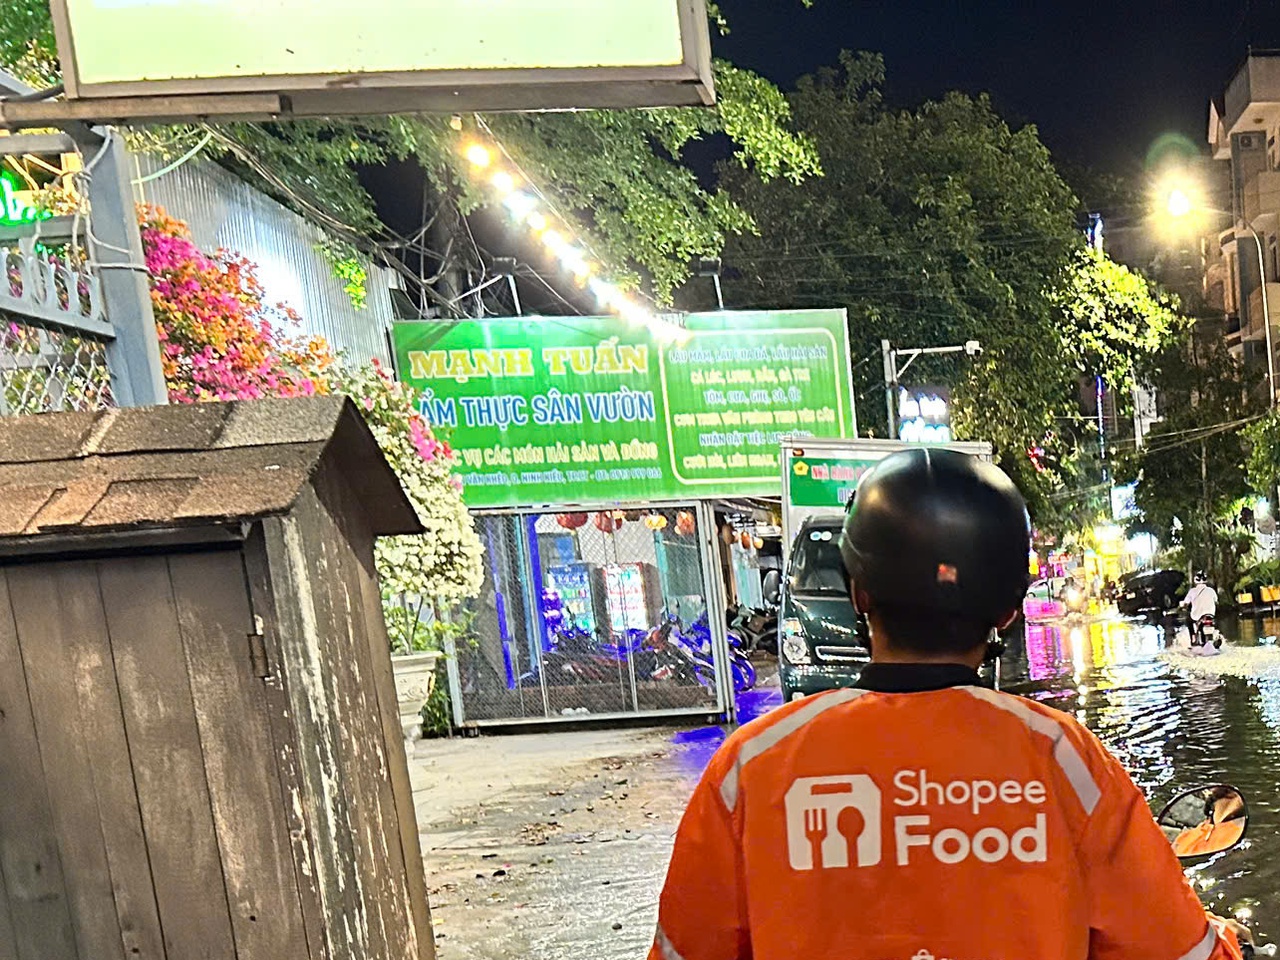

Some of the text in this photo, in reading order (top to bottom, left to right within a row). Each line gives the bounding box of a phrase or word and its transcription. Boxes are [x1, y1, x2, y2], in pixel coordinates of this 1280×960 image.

[408, 337, 647, 383] MẠNH TUẤN
[418, 385, 656, 431] ẨM THỰC SÂN VƯỜN
[462, 448, 482, 468] VỤ
[484, 444, 512, 465] CÁC
[513, 443, 544, 464] MÓN
[600, 440, 620, 461] VÀ
[893, 769, 1046, 815] Shopee
[895, 813, 1047, 866] Food
